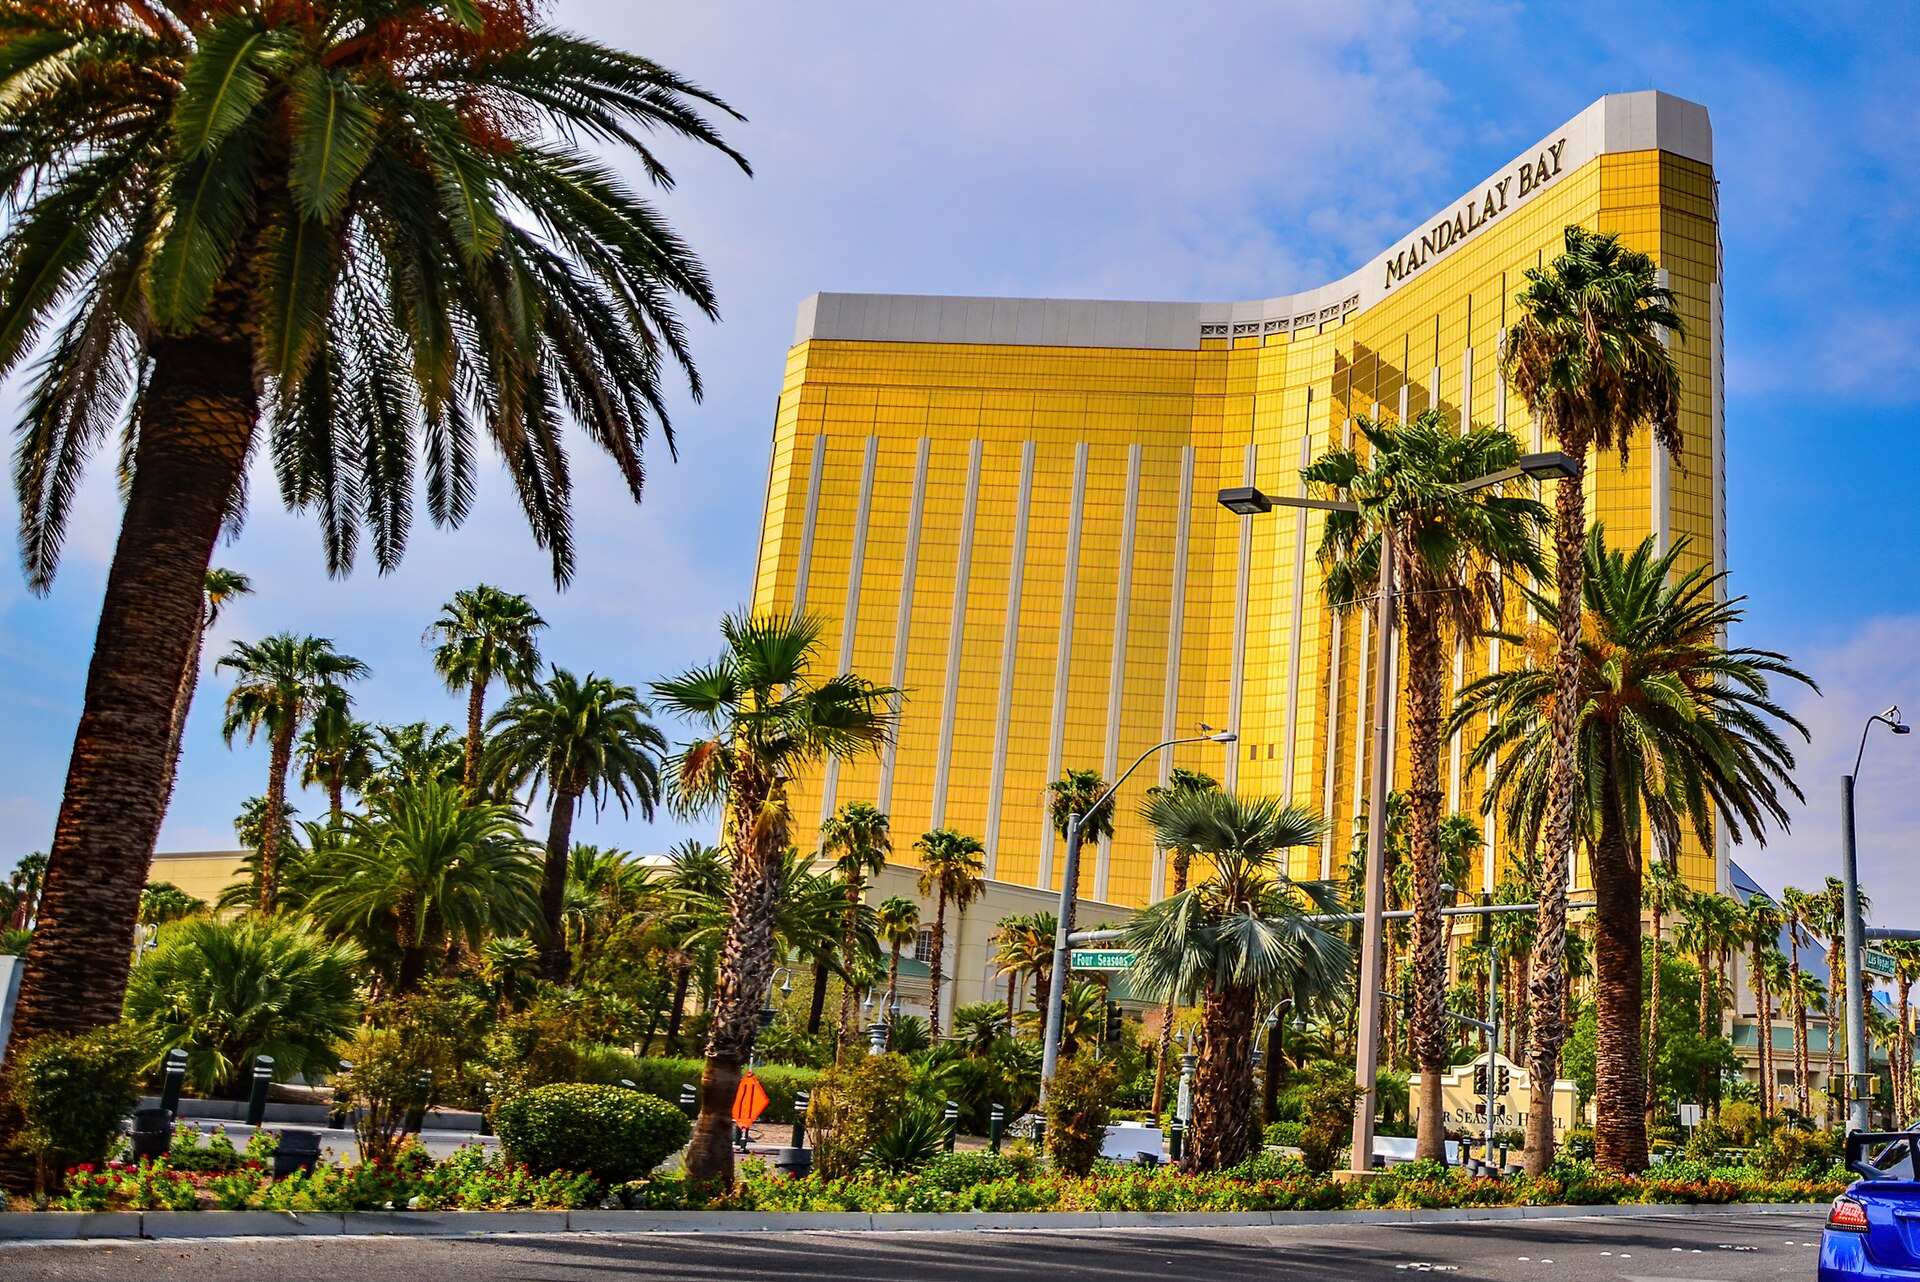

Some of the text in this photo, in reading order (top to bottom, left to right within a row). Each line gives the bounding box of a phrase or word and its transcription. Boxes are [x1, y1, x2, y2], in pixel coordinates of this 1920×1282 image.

[1384, 138, 1566, 289] MANDALAY BAY
[1077, 953, 1128, 967] Four Seasons
